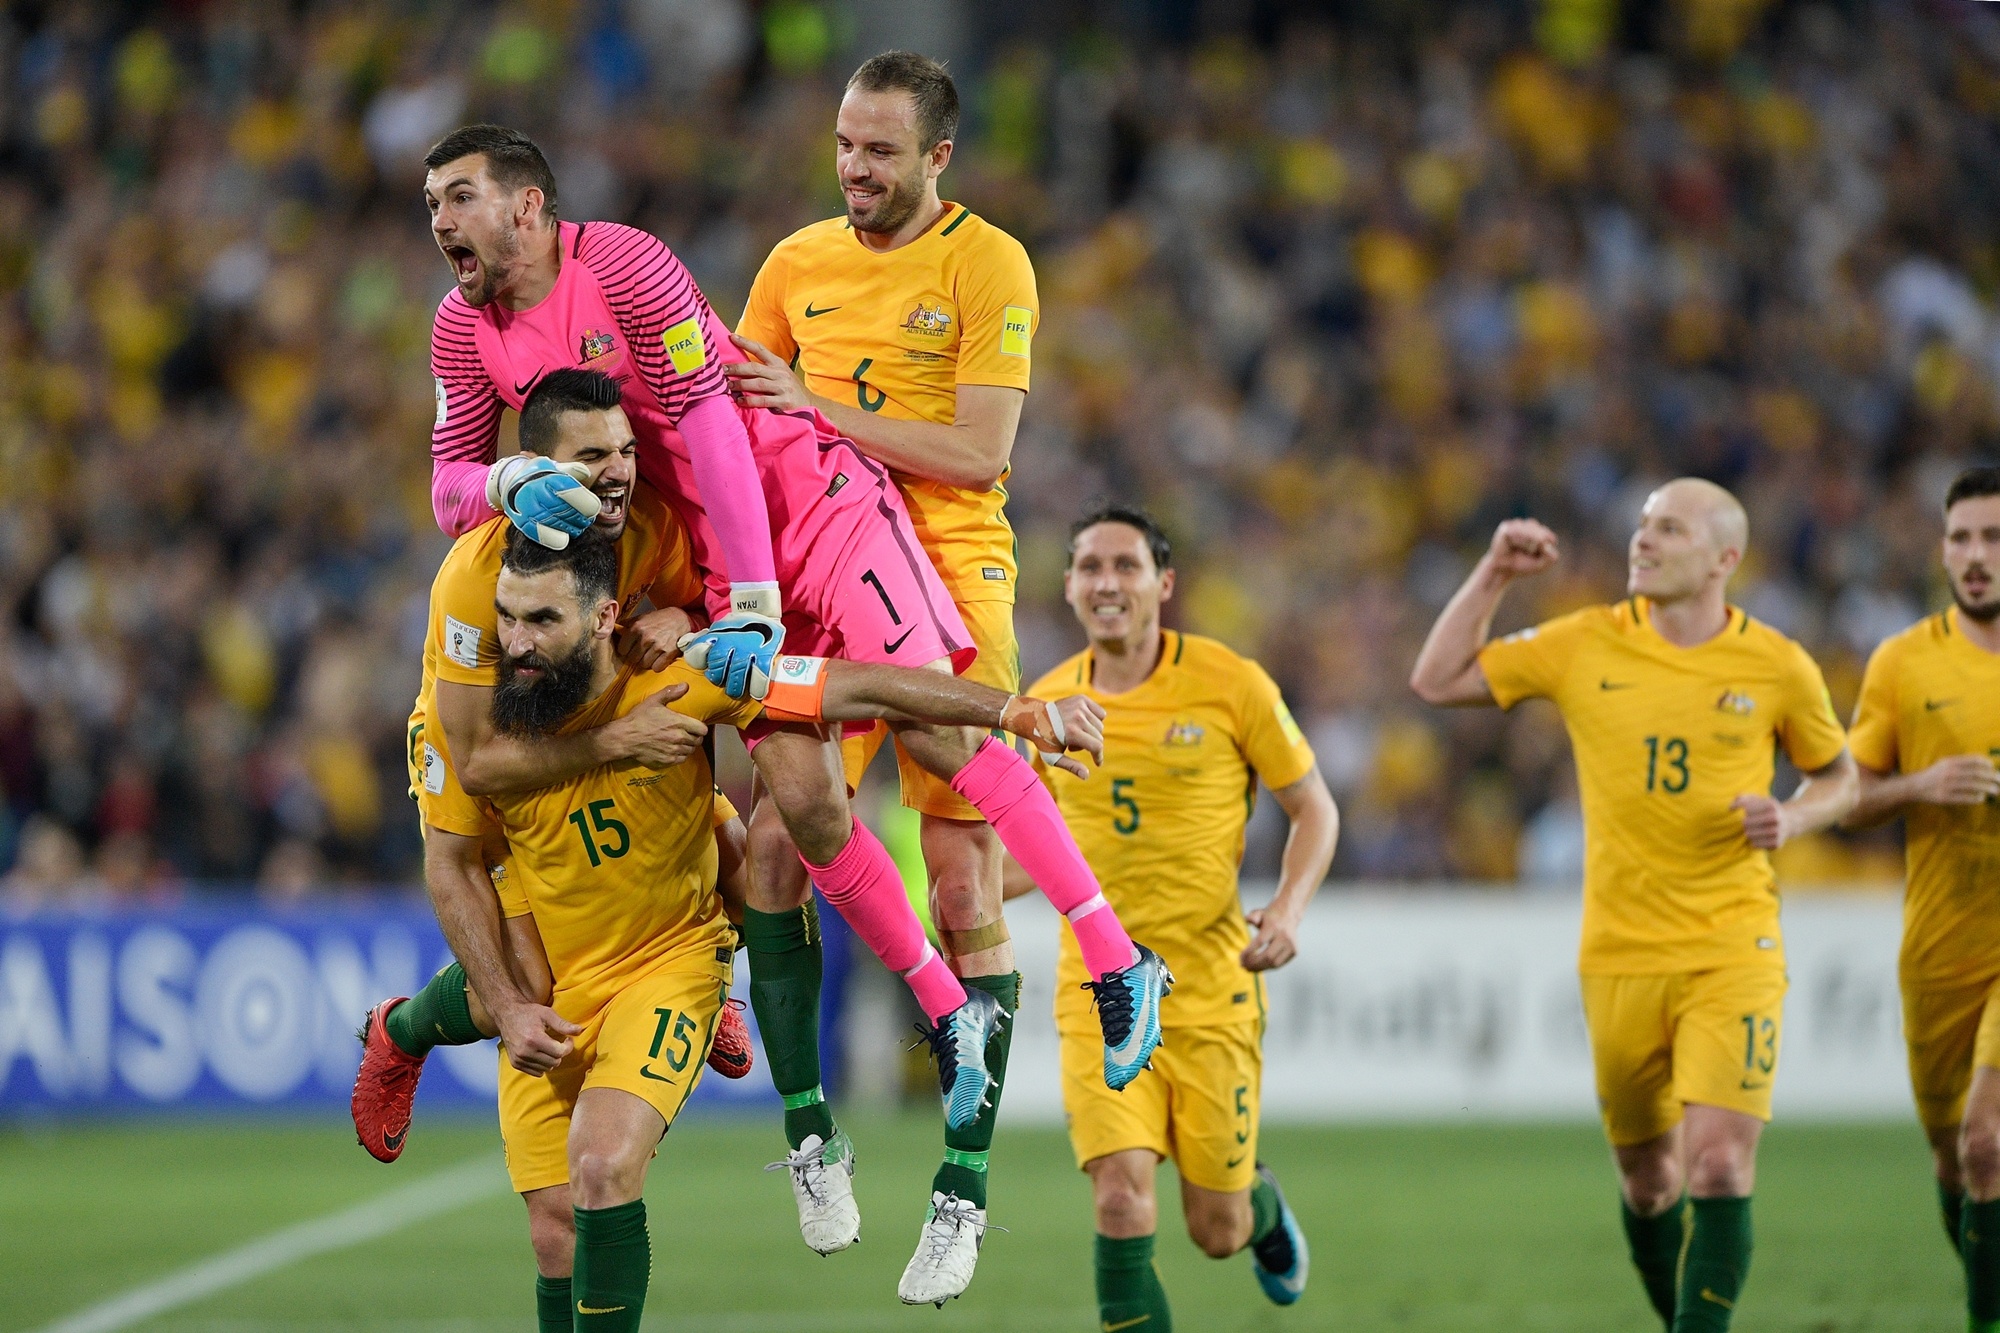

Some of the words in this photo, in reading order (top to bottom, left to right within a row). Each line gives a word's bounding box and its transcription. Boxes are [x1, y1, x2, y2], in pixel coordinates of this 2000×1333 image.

[669, 338, 693, 354] FIFA
[905, 327, 945, 338] AUSTRALIA
[1006, 322, 1027, 333] FIFA
[852, 357, 887, 412] 6
[736, 600, 758, 610] RYAN
[860, 568, 902, 626] 1
[446, 617, 479, 636] QUALIFIERS
[1644, 736, 1689, 793] 13
[568, 798, 630, 868] 15
[1112, 777, 1140, 836] 5
[647, 1007, 697, 1073] 15
[1741, 1014, 1776, 1074] 13
[1235, 1085, 1252, 1145] 5
